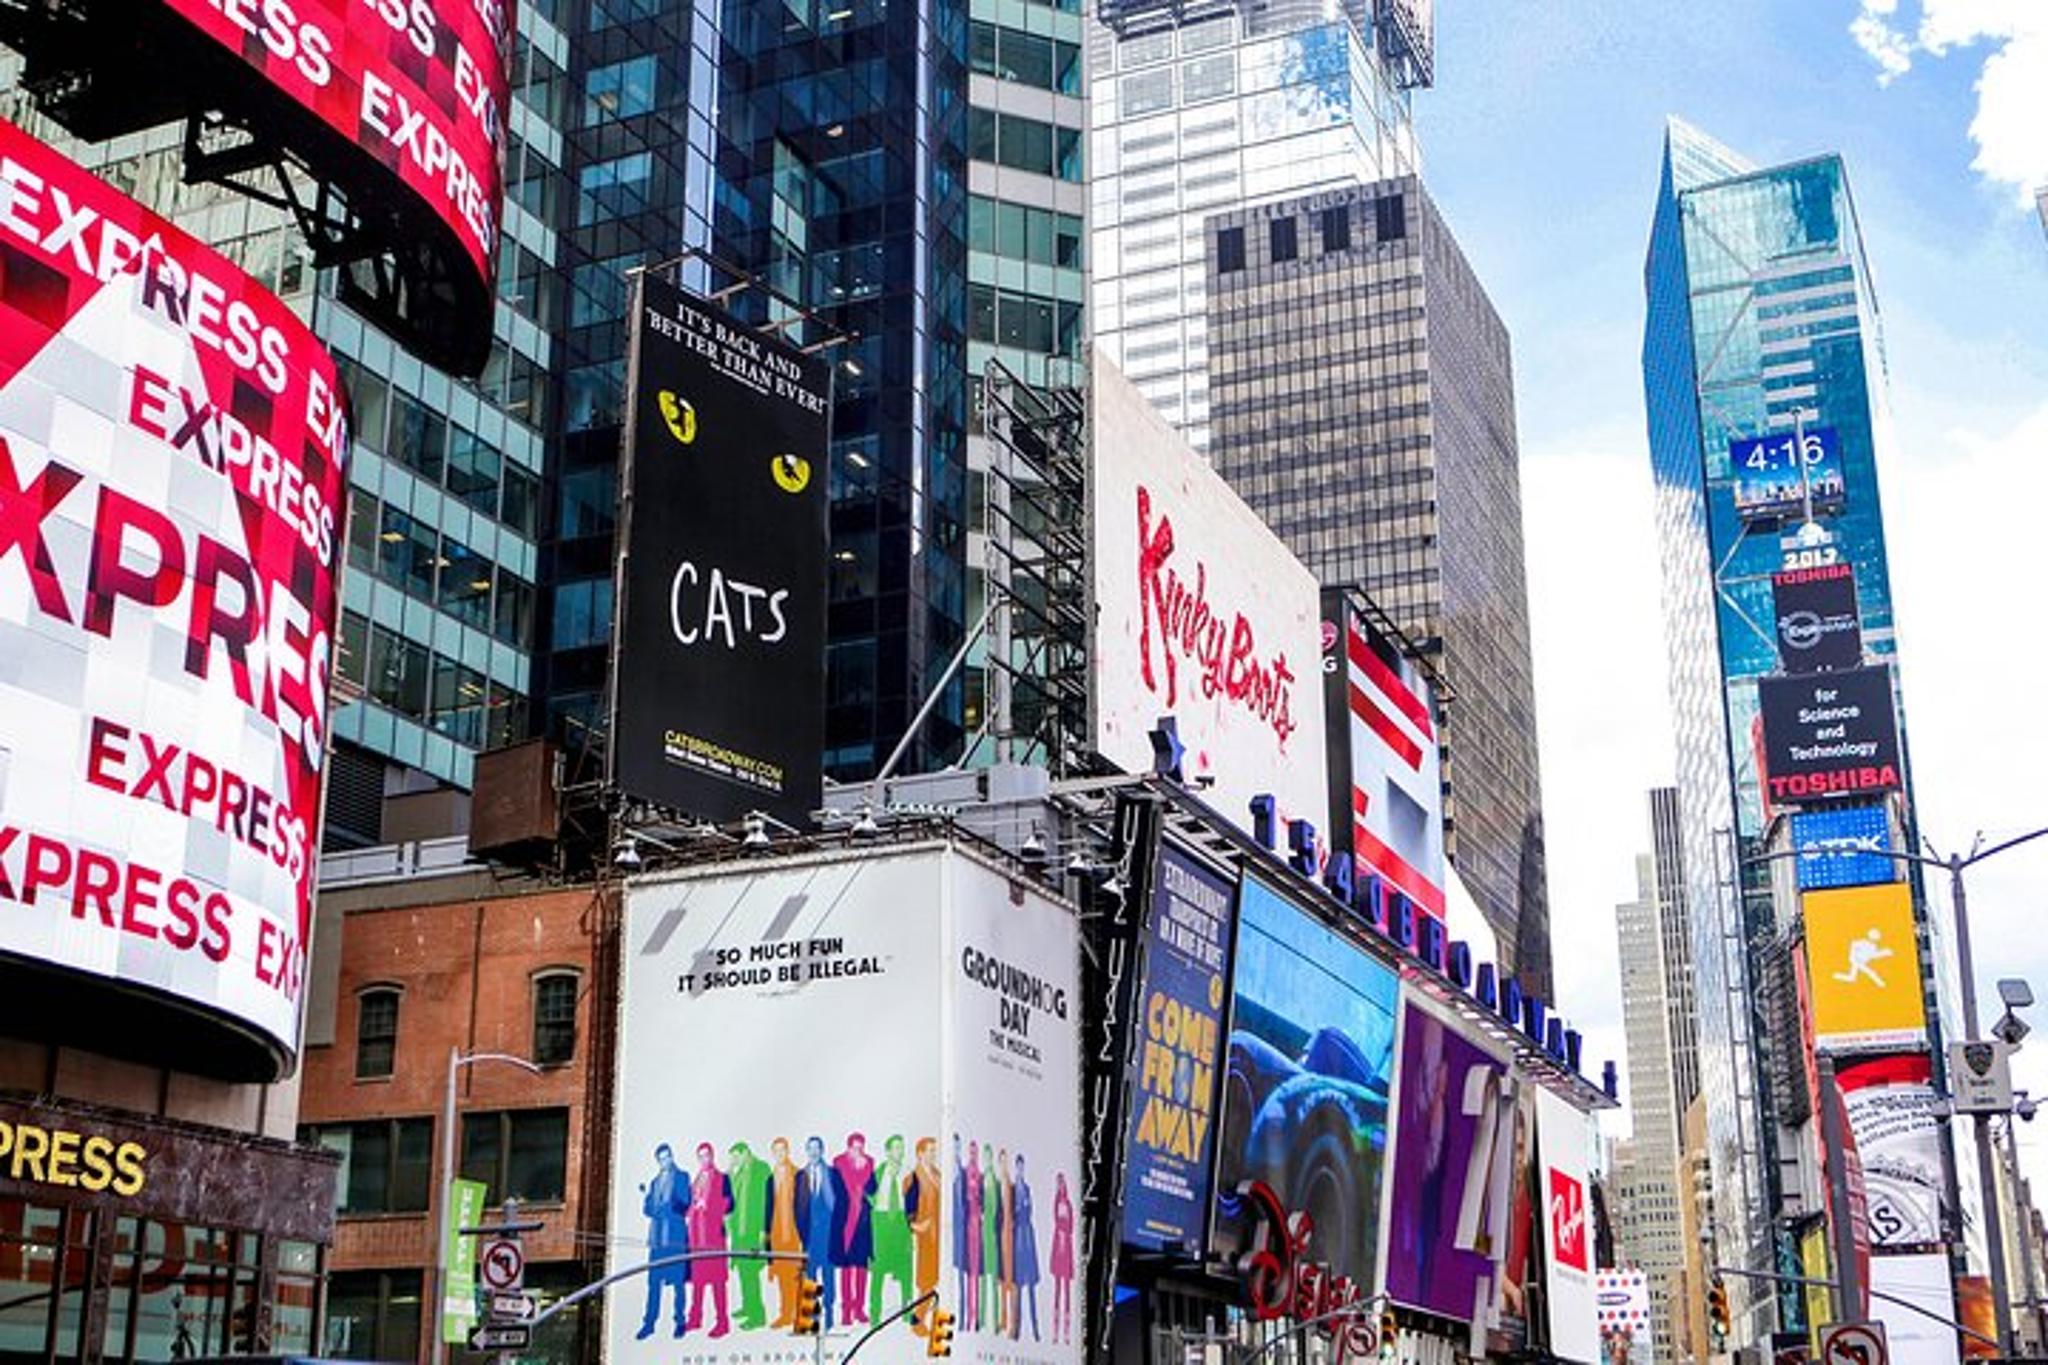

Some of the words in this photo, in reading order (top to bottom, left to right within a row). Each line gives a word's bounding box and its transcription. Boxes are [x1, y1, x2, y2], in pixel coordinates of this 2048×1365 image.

[208, 0, 332, 87] ESS
[0, 156, 288, 394] EXPRESS
[677, 303, 711, 333] IT'S
[716, 324, 760, 361] BACK
[764, 351, 801, 380] AND
[722, 349, 772, 386] THAN
[129, 365, 333, 567] EXPRESS
[1746, 435, 1824, 472] 4:16
[1774, 564, 1851, 586] TOSHIBA
[670, 561, 789, 649] CATS
[1799, 705, 1860, 724] Science
[1815, 688, 1838, 703] for
[1789, 741, 1879, 761] Technology
[1816, 724, 1845, 740] and
[87, 716, 306, 884] EXPRESS
[1769, 764, 1898, 797] TOSHIBA
[1249, 793, 1383, 926] 1540
[749, 942, 801, 962] MUCH
[808, 937, 844, 957] FUN
[677, 974, 697, 993] IT
[703, 968, 772, 991] SHOULD
[778, 963, 800, 983] BE
[963, 946, 1067, 1020] GROUNDHOG
[1001, 996, 1030, 1037] DAY
[1149, 992, 1217, 1065] COME
[1142, 1038, 1213, 1114] FROM
[1136, 1094, 1208, 1165] AWAY
